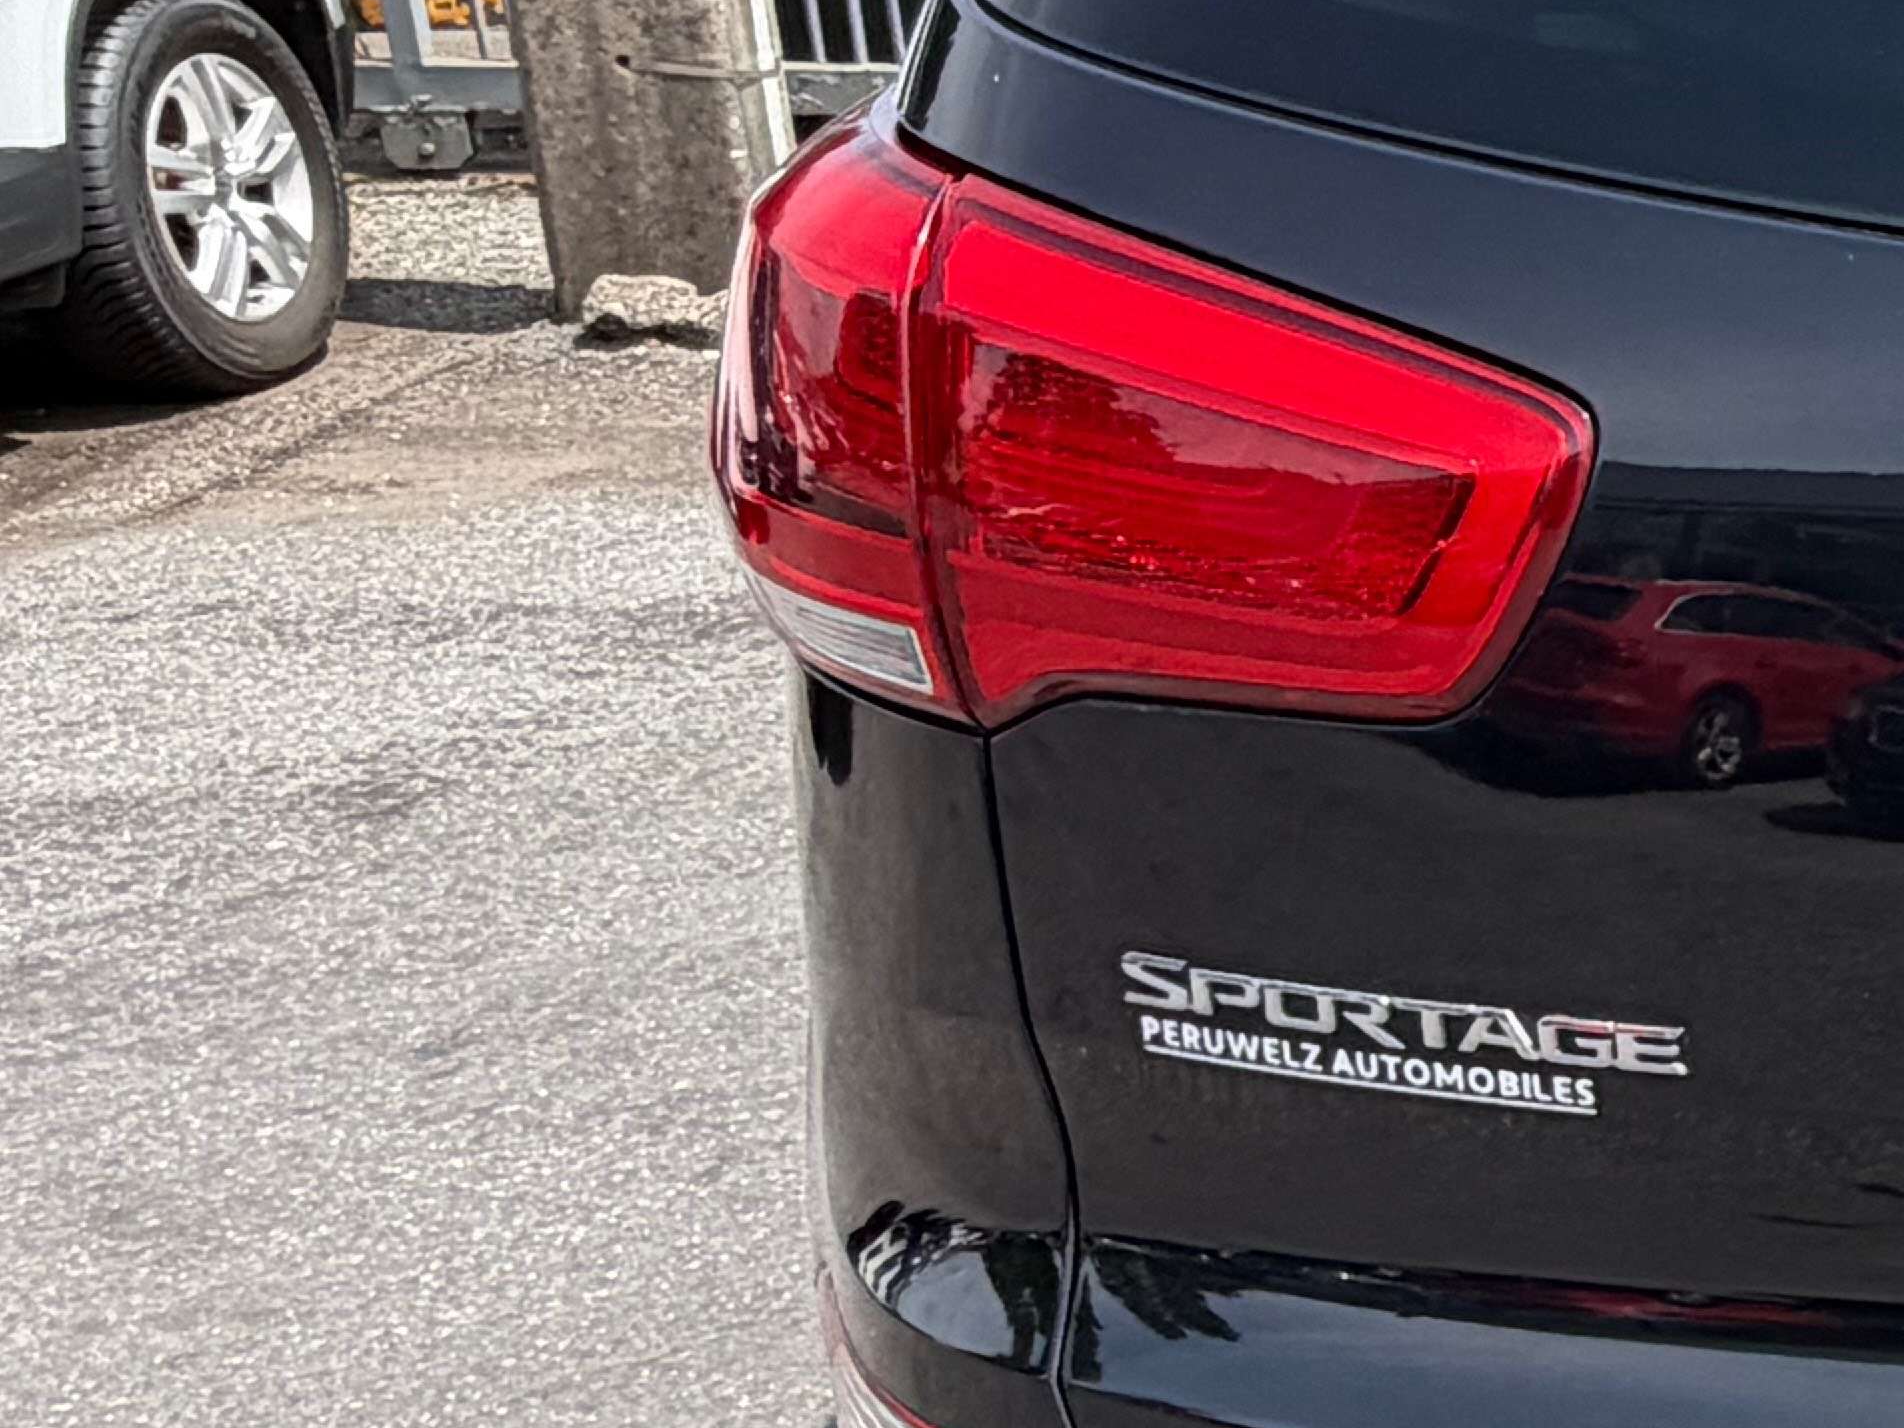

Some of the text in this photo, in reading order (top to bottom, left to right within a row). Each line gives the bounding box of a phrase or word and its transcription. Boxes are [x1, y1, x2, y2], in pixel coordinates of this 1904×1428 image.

[1120, 950, 1688, 1076] SPORTAGE
[1140, 1014, 1597, 1107] PERUWELZ AUTOMOBILES
